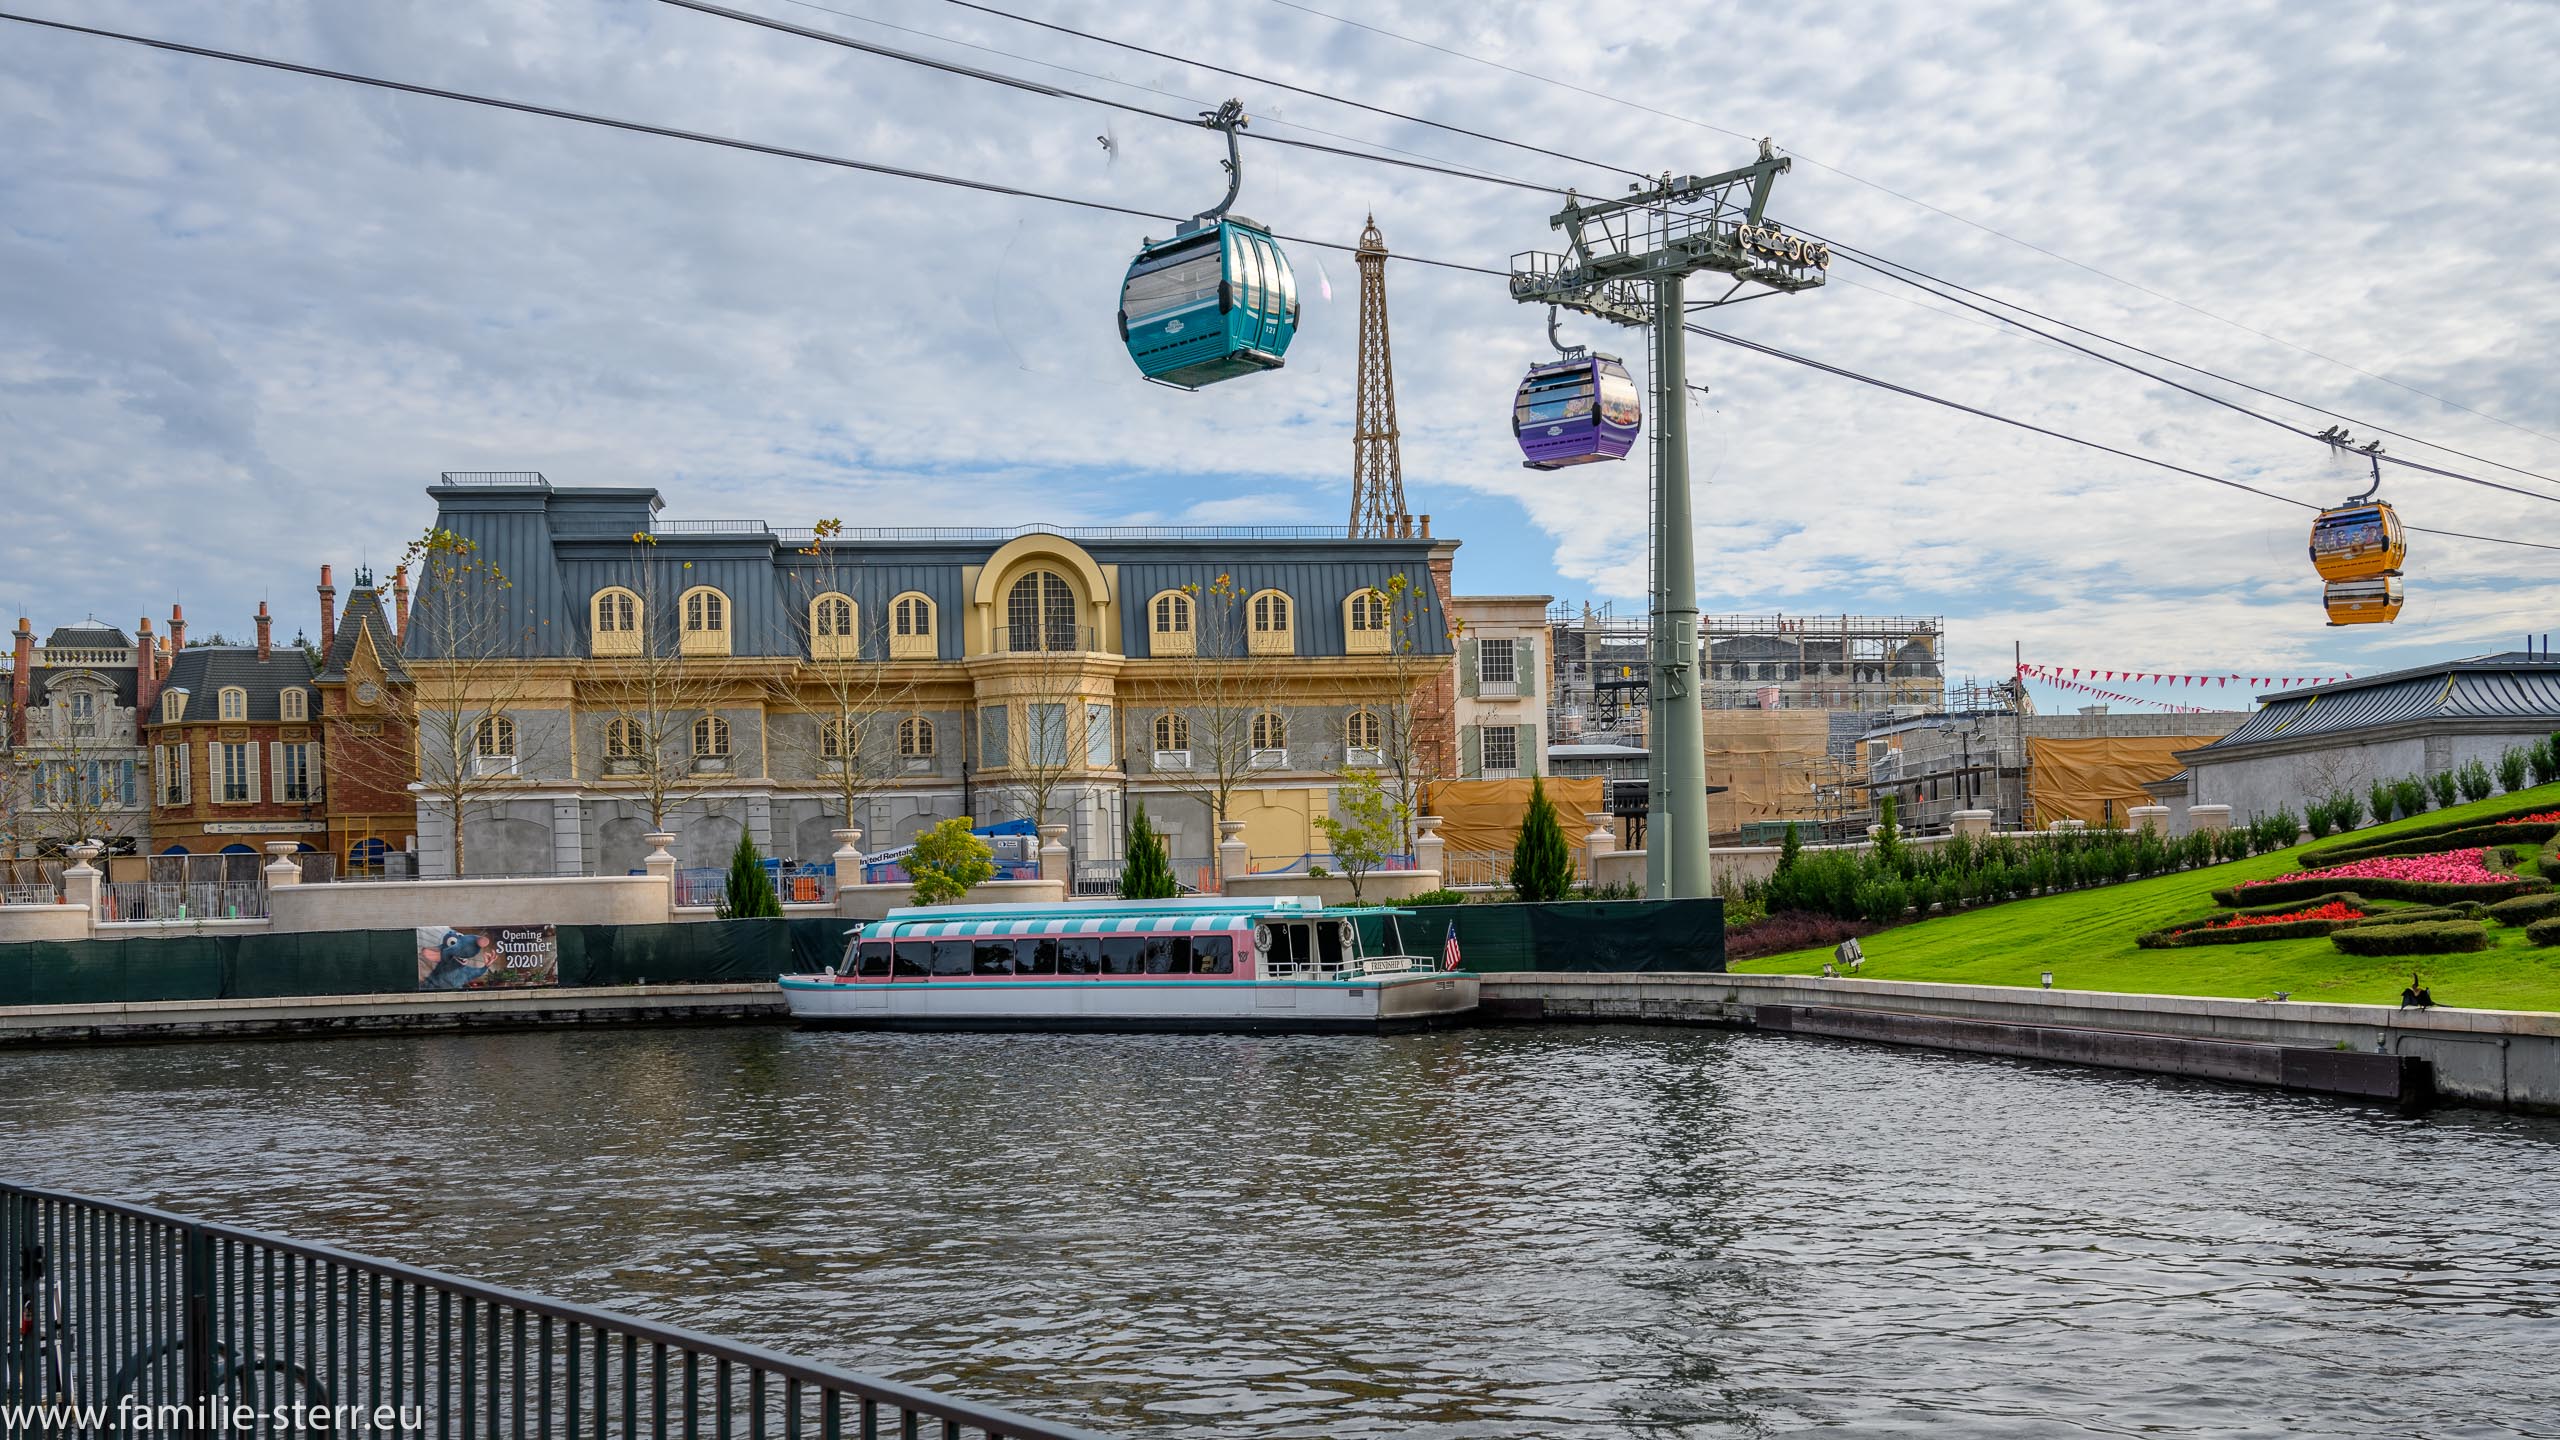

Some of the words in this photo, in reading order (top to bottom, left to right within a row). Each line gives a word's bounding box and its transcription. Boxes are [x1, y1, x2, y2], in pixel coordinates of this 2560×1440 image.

[883, 848, 913, 861] Rentals
[502, 929, 543, 942] Opening
[495, 940, 552, 954] Summer
[506, 954, 544, 969] 2020!
[1371, 960, 1400, 971] FRIENDSHIP
[1401, 960, 1405, 968] V
